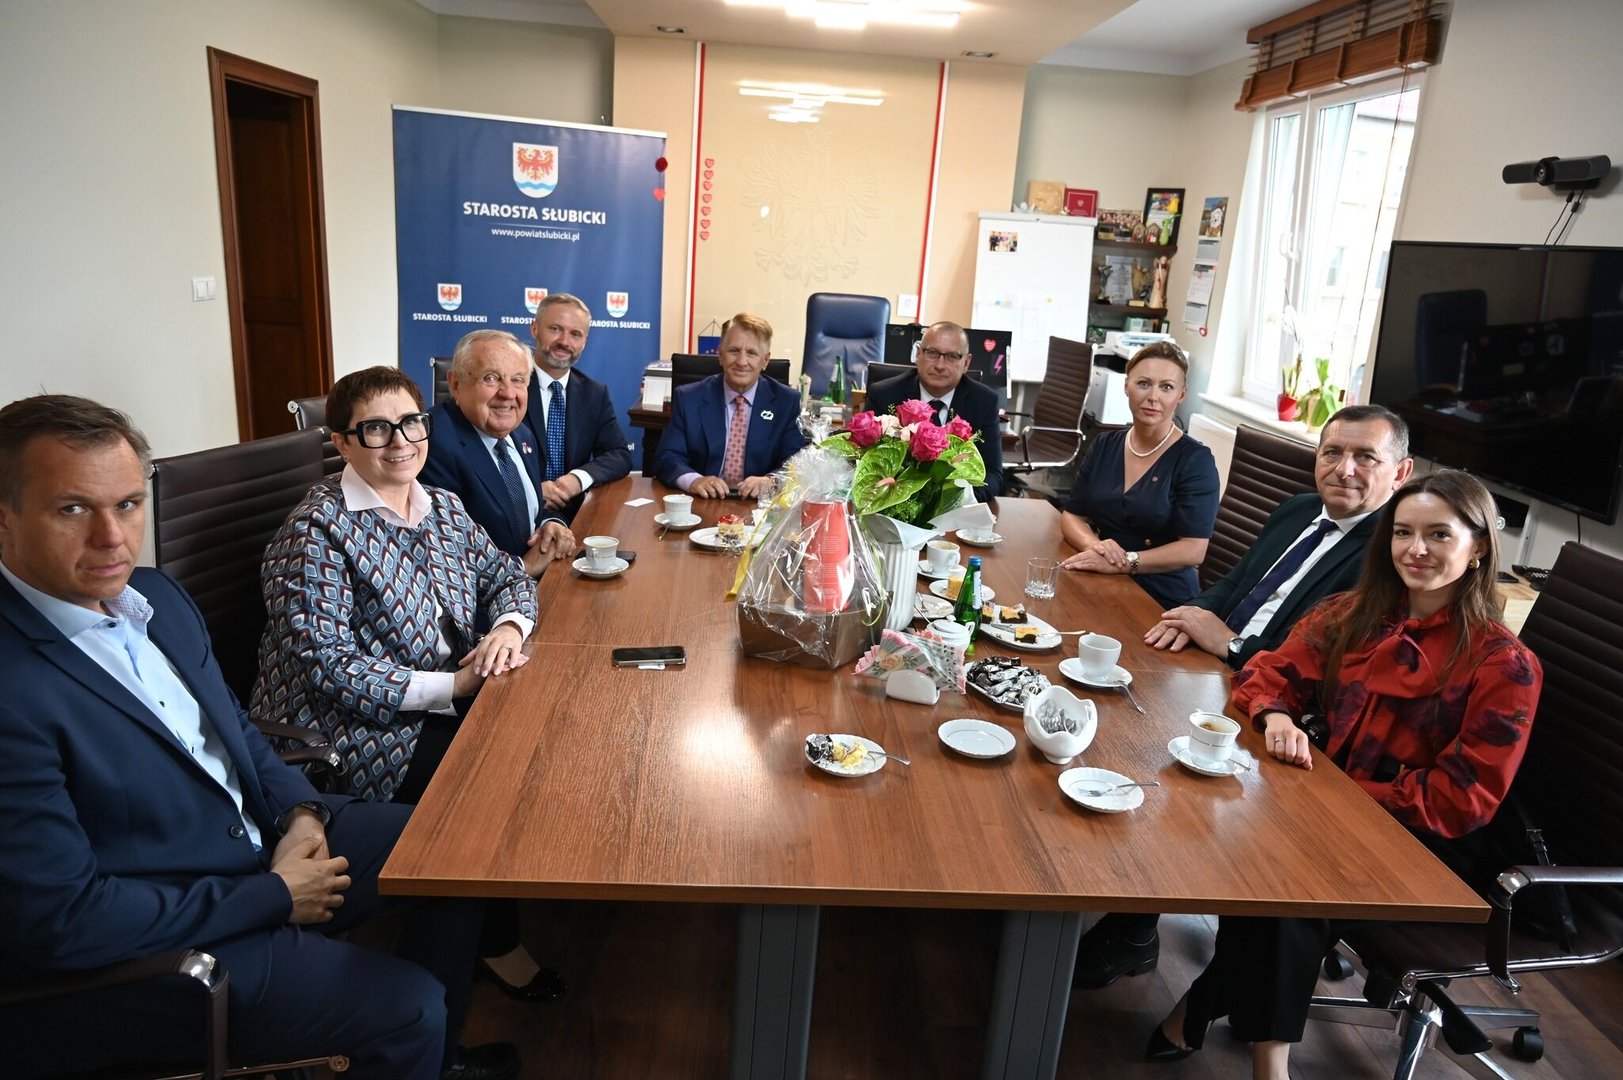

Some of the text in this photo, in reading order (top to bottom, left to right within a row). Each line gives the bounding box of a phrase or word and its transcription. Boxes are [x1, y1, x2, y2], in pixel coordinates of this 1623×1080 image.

[462, 201, 607, 225] STAROSTA SŁUBICKI
[491, 228, 580, 242] www.powiatslubicki.pl
[412, 313, 488, 323] STAROSTA SŁUBICKI
[501, 316, 534, 325] STAROST
[589, 320, 651, 329] TAROSTA SŁUBICKI
